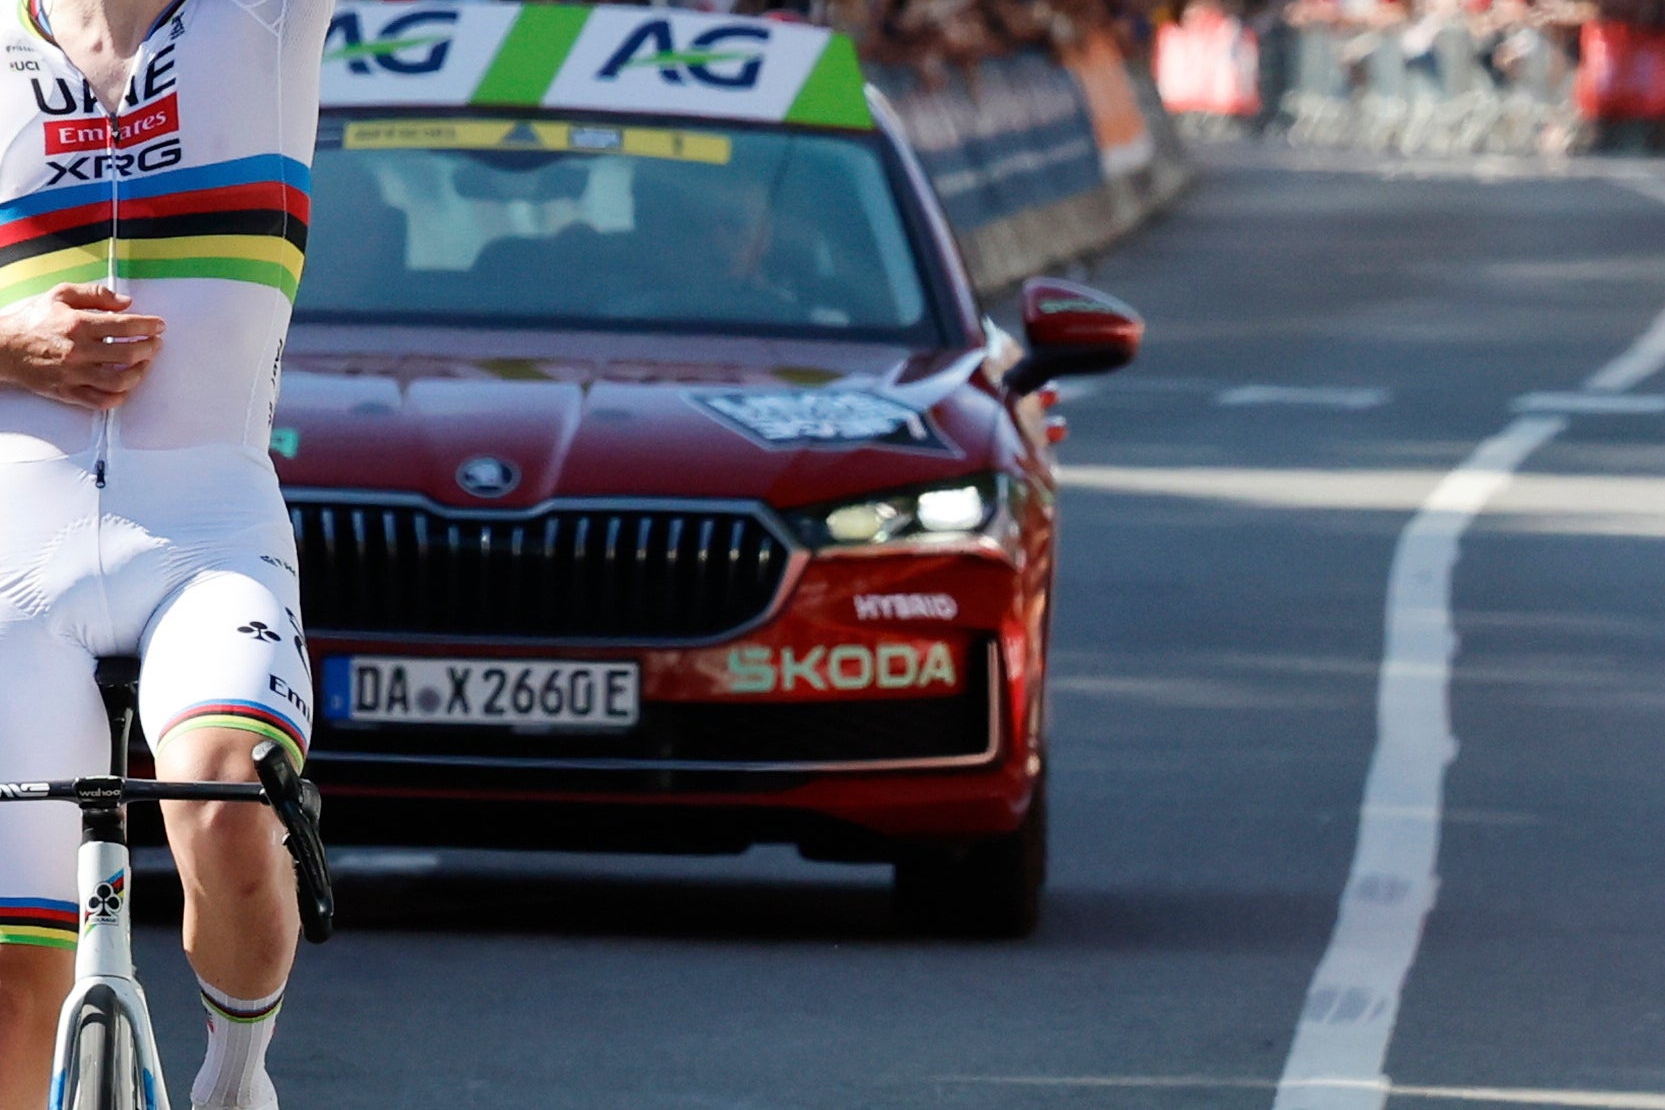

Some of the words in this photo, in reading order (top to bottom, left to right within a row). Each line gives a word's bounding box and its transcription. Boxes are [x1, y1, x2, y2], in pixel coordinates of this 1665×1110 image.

[15, 60, 40, 72] UCI
[597, 19, 773, 91] AG
[46, 139, 182, 186] XRG
[853, 592, 958, 620] HYBRID
[78, 786, 121, 798] wahoo
